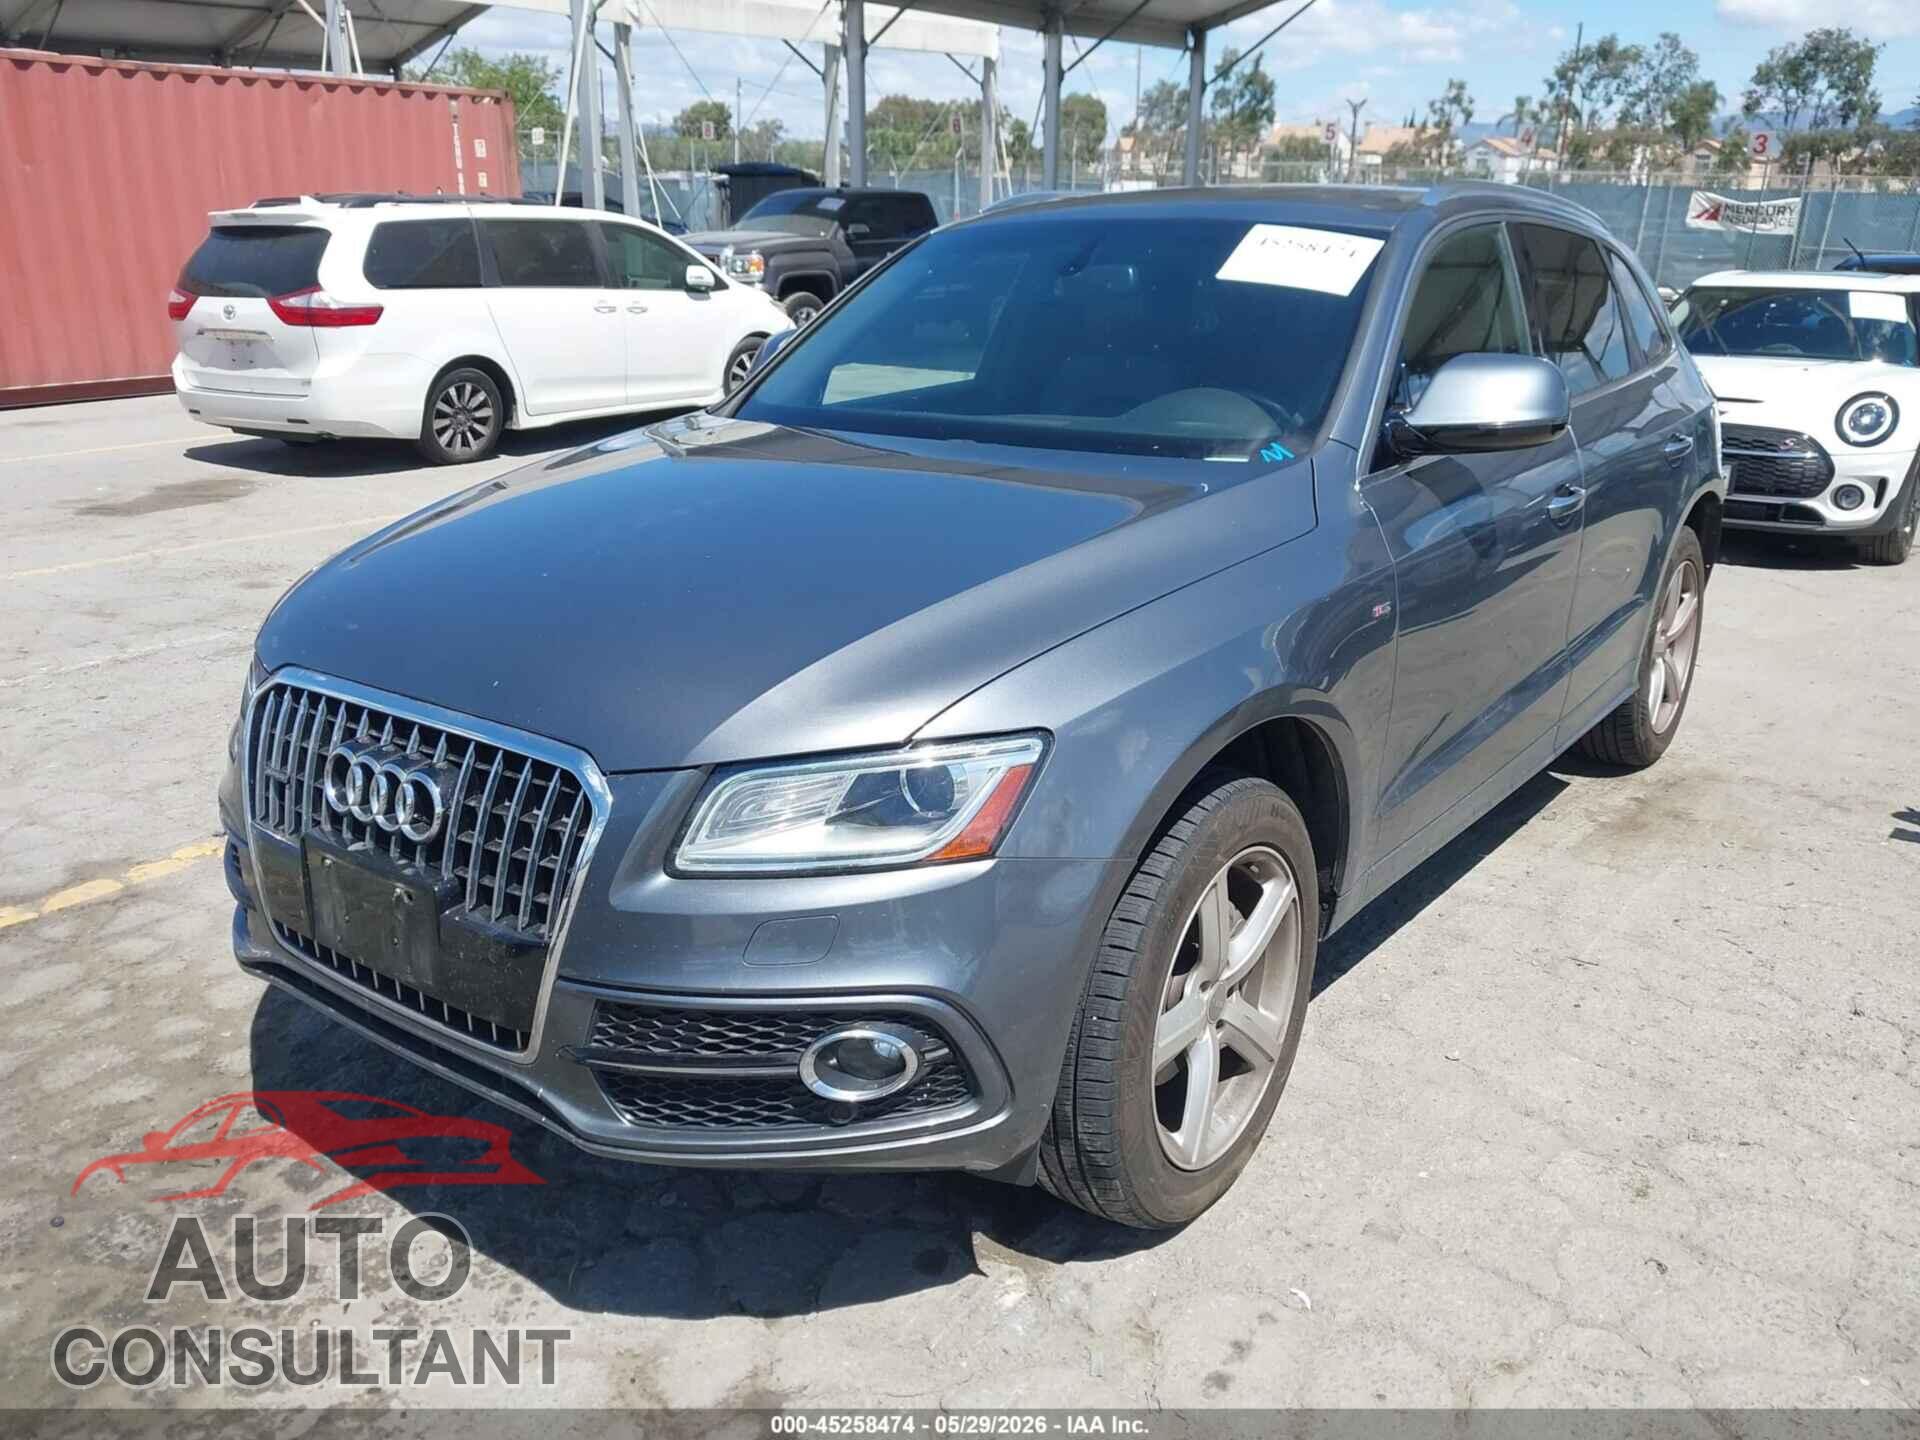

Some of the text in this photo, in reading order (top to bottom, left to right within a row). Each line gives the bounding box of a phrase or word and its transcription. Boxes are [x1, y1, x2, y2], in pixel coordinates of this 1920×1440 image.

[1326, 123, 1335, 141] 5
[1753, 133, 1768, 154] 3
[1725, 203, 1794, 217] MERCURY
